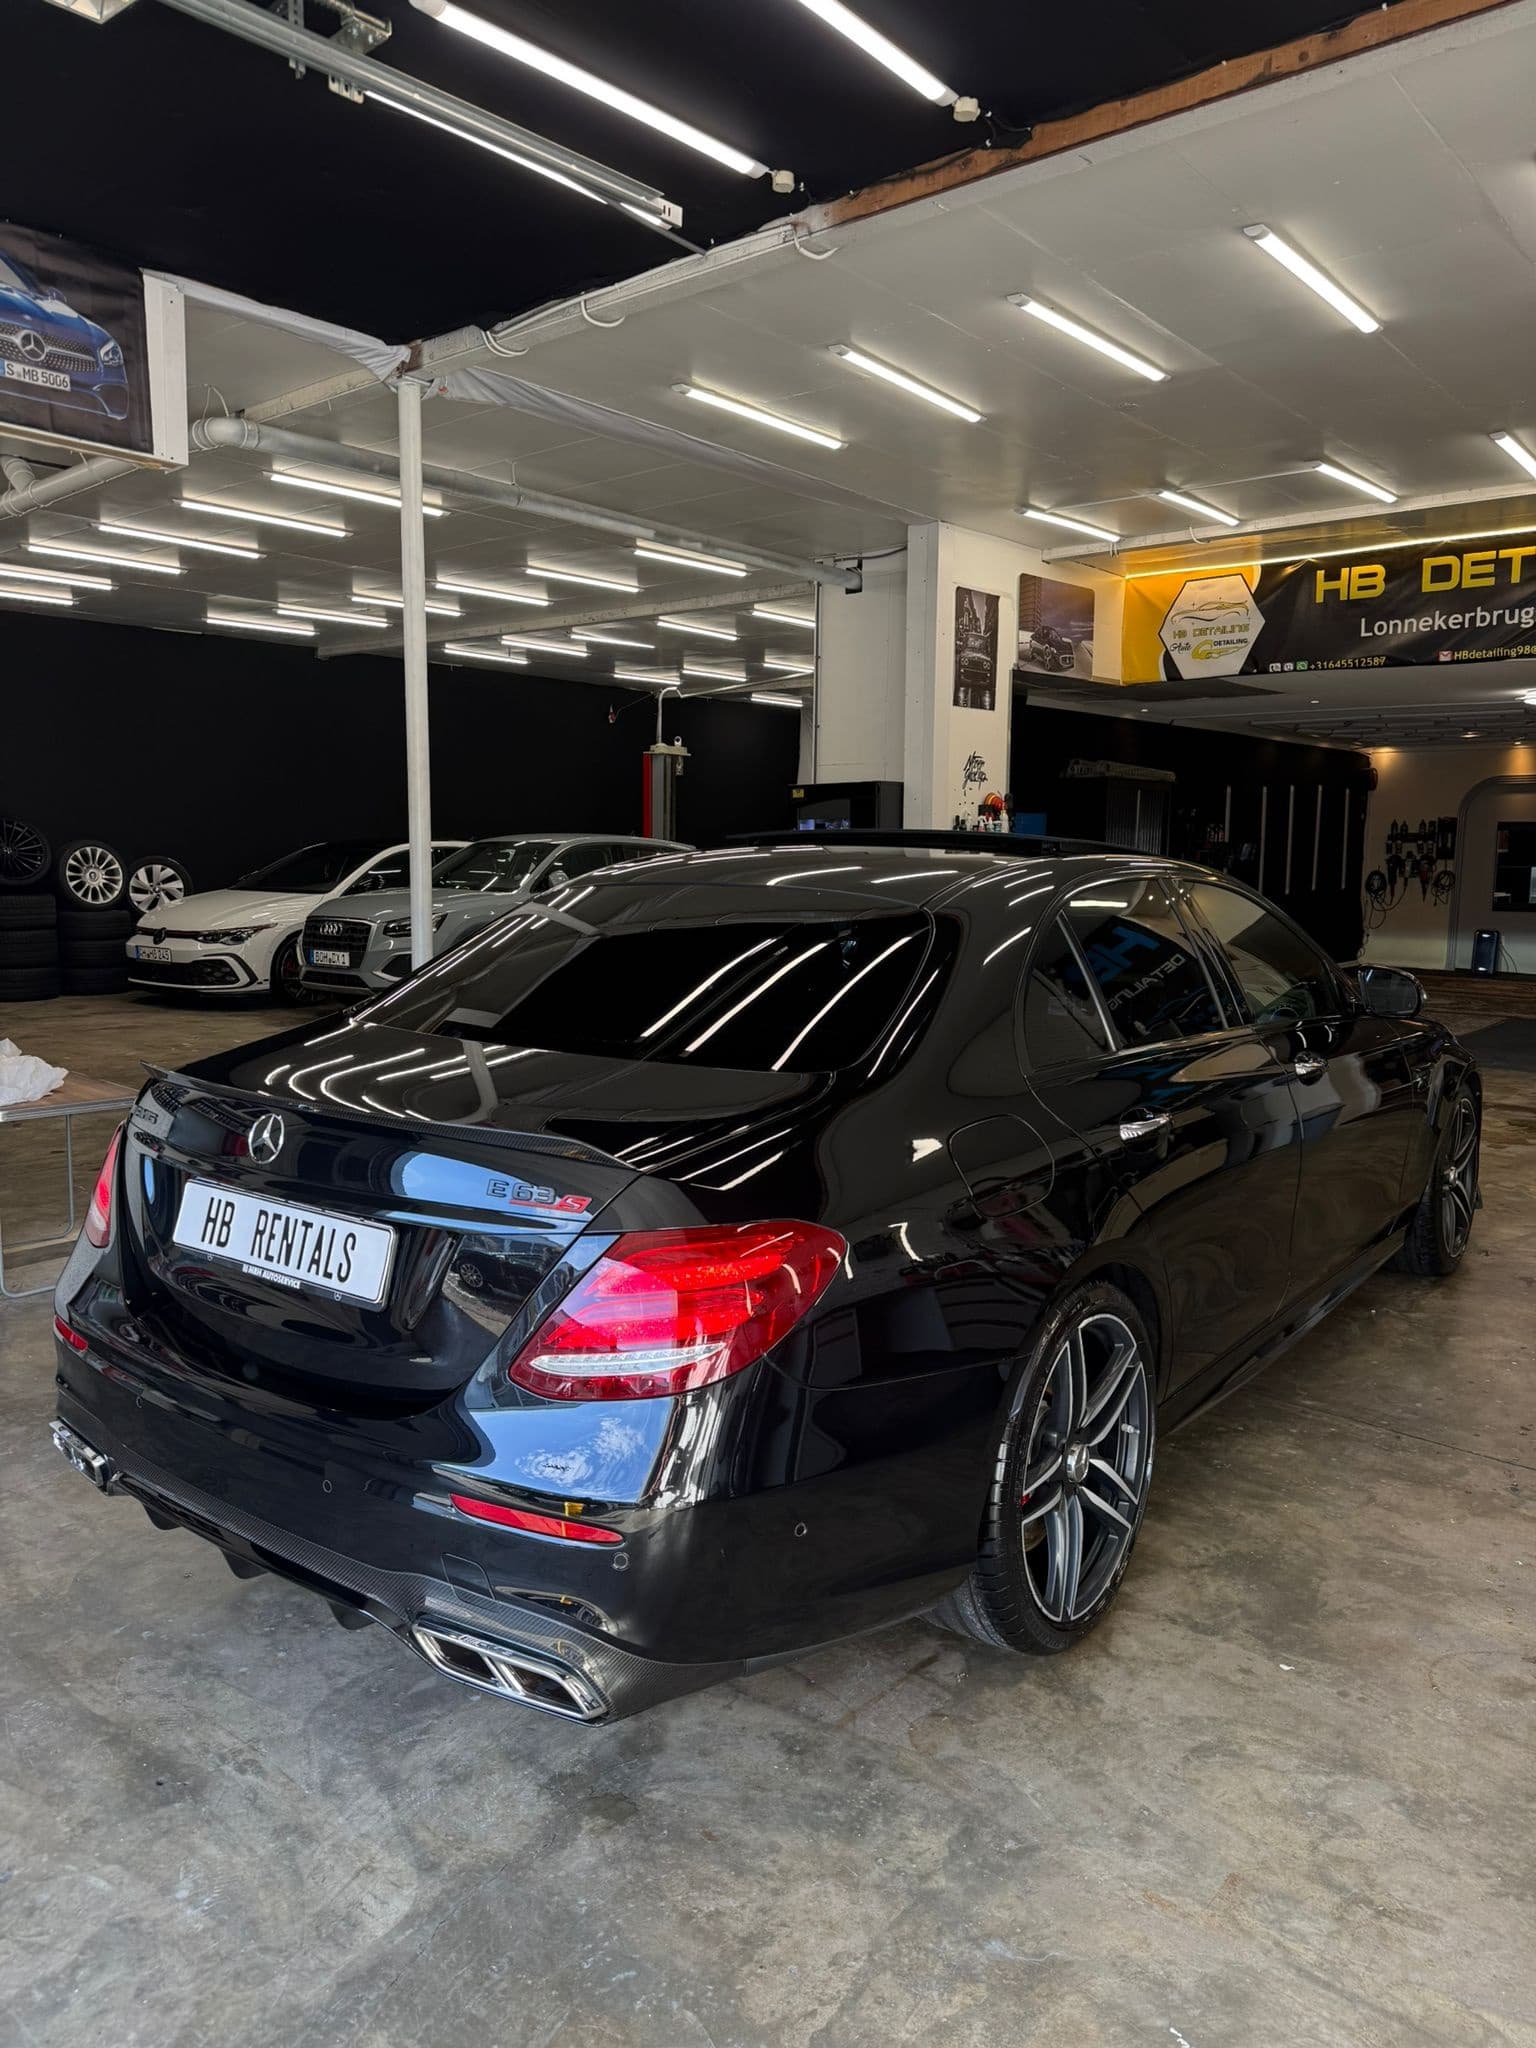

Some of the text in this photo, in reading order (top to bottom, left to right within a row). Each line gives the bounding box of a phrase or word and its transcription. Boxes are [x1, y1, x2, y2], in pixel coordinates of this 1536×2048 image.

[6, 363, 69, 388] S MB 5006
[1315, 546, 1536, 604] HB DET
[1360, 606, 1535, 637] Lonnekerbrug
[1214, 639, 1249, 647] DETAILING
[201, 1197, 356, 1284] HB RENTALS
